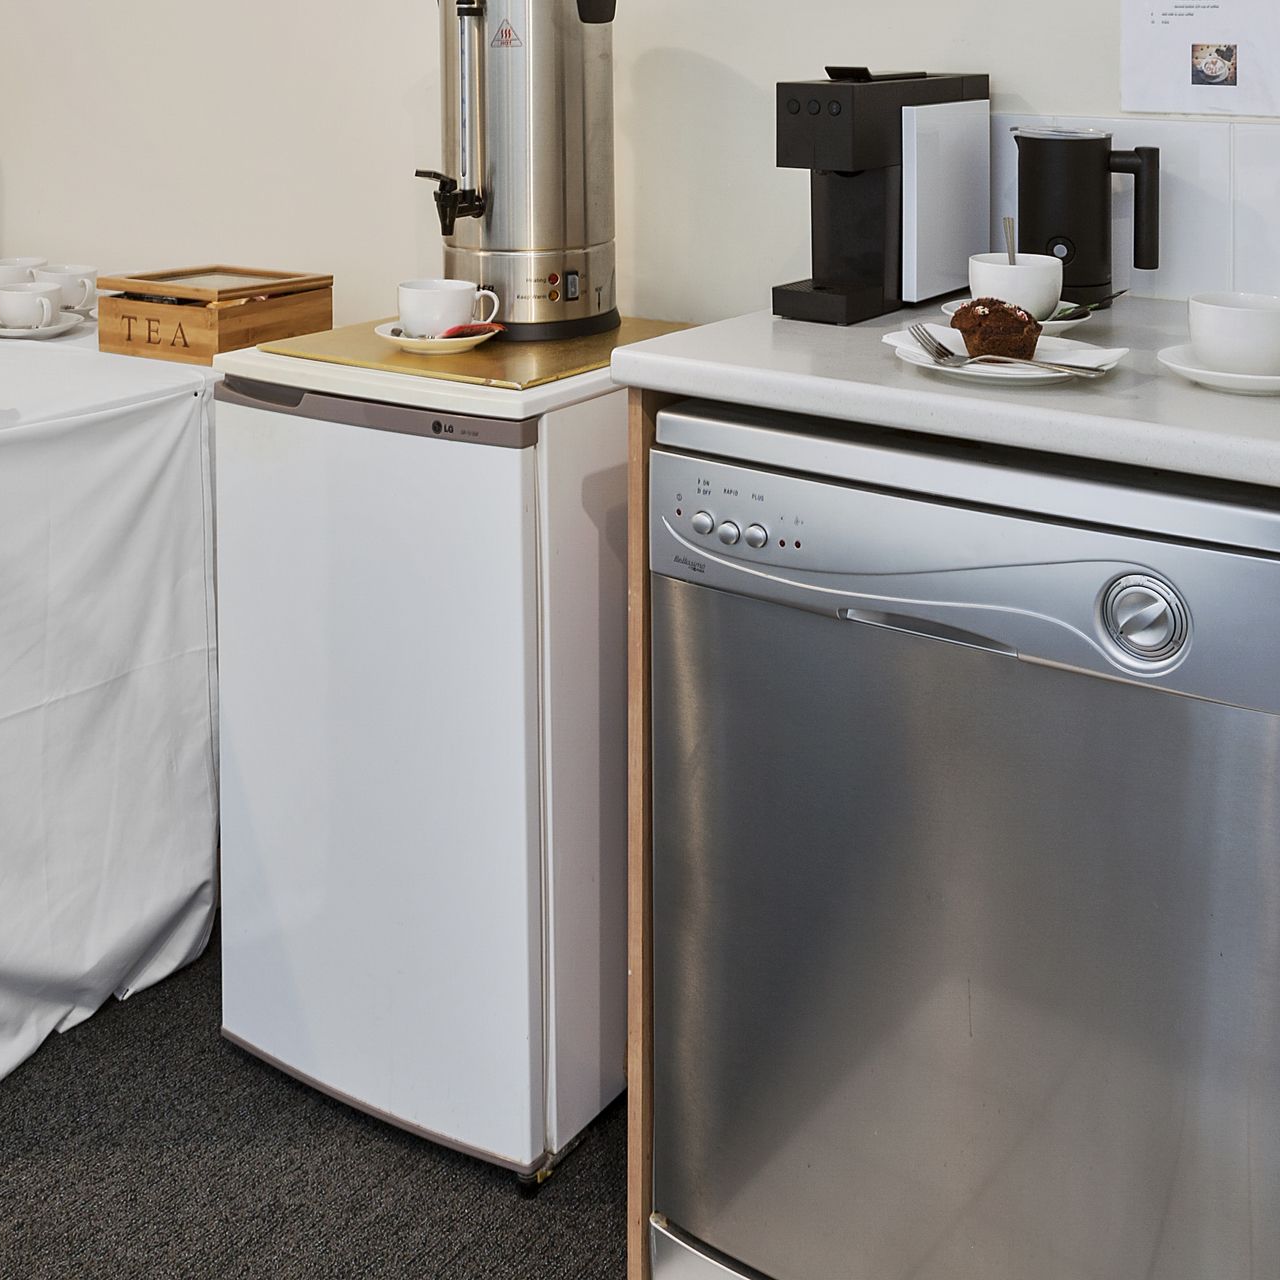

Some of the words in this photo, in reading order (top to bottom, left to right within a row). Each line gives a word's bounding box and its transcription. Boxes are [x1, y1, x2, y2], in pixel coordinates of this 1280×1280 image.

[121, 314, 190, 348] TEA
[443, 423, 454, 433] LG
[703, 478, 710, 487] ON
[723, 488, 739, 497] RAPID
[751, 493, 765, 502] PLUS
